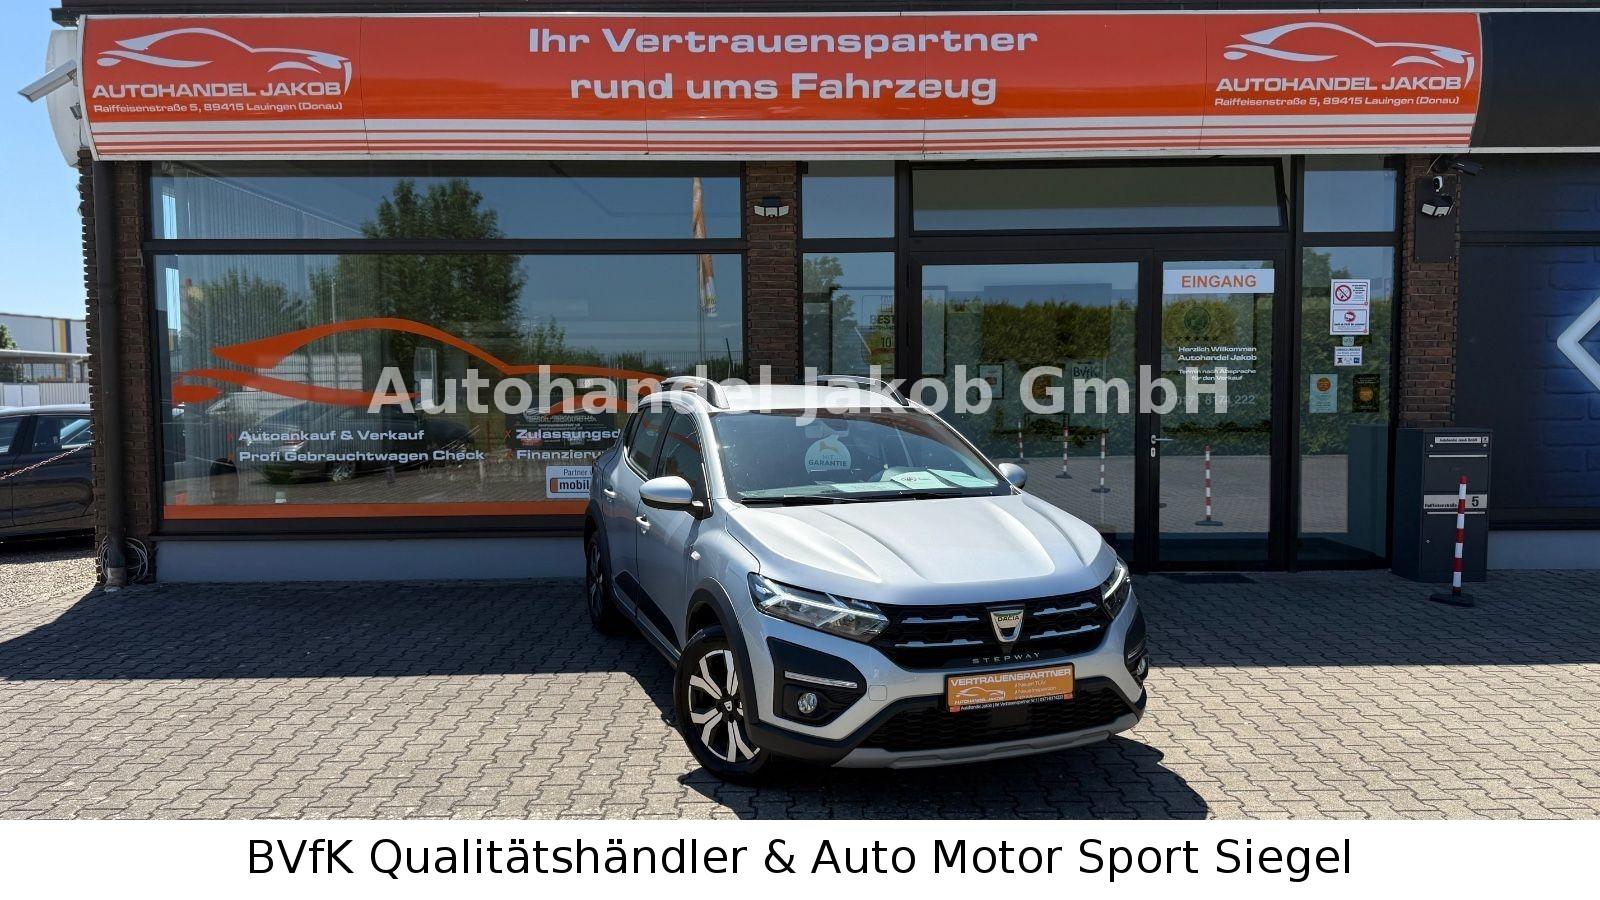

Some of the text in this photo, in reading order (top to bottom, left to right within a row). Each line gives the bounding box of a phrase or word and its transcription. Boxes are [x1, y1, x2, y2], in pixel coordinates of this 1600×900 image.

[529, 28, 1038, 60] Ihr Vertrauenspartner
[571, 72, 997, 106] rund ums Fahrzeug
[1216, 76, 1462, 92] AUTOHANDEL JAKOB
[92, 82, 342, 99] AUTOHANDEL JAKOB
[94, 102, 343, 113] Raiffeisenstraße 5, 89415 Lauingen (Donau)
[1214, 96, 1460, 107] Raiffeisenstraße 5, 89415 Lauingen (Donau)
[1181, 275, 1257, 288] EINGANG
[238, 430, 425, 441] Autoankauf & Verkauf
[239, 449, 486, 464] Profi Gebrauchtwagen Check
[808, 459, 849, 467] GARANTIE
[563, 468, 587, 476] Partner
[559, 479, 590, 490] mobil
[1471, 496, 1480, 507] 5
[972, 652, 1041, 664] STEPWAY
[950, 668, 1072, 687] VERTRAUENSPARTNER
